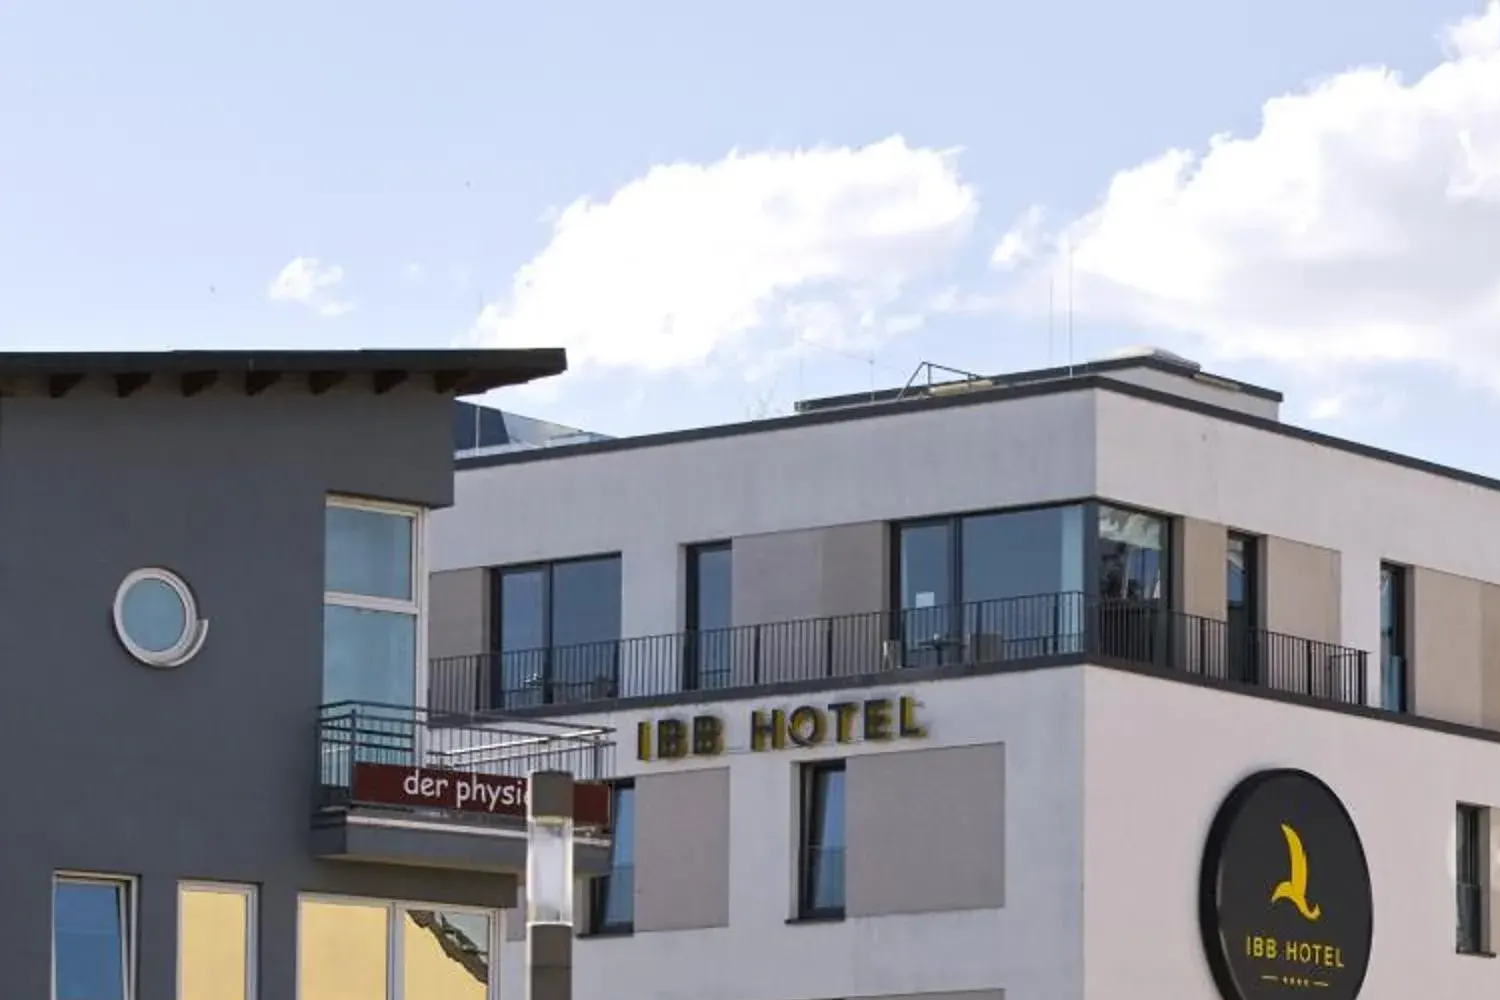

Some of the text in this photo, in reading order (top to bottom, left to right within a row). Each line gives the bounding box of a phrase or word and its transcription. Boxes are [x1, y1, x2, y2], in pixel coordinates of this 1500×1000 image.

[637, 696, 926, 762] IBB HOTEL
[403, 769, 531, 812] der physi
[1246, 936, 1344, 968] IBB HOTEL
